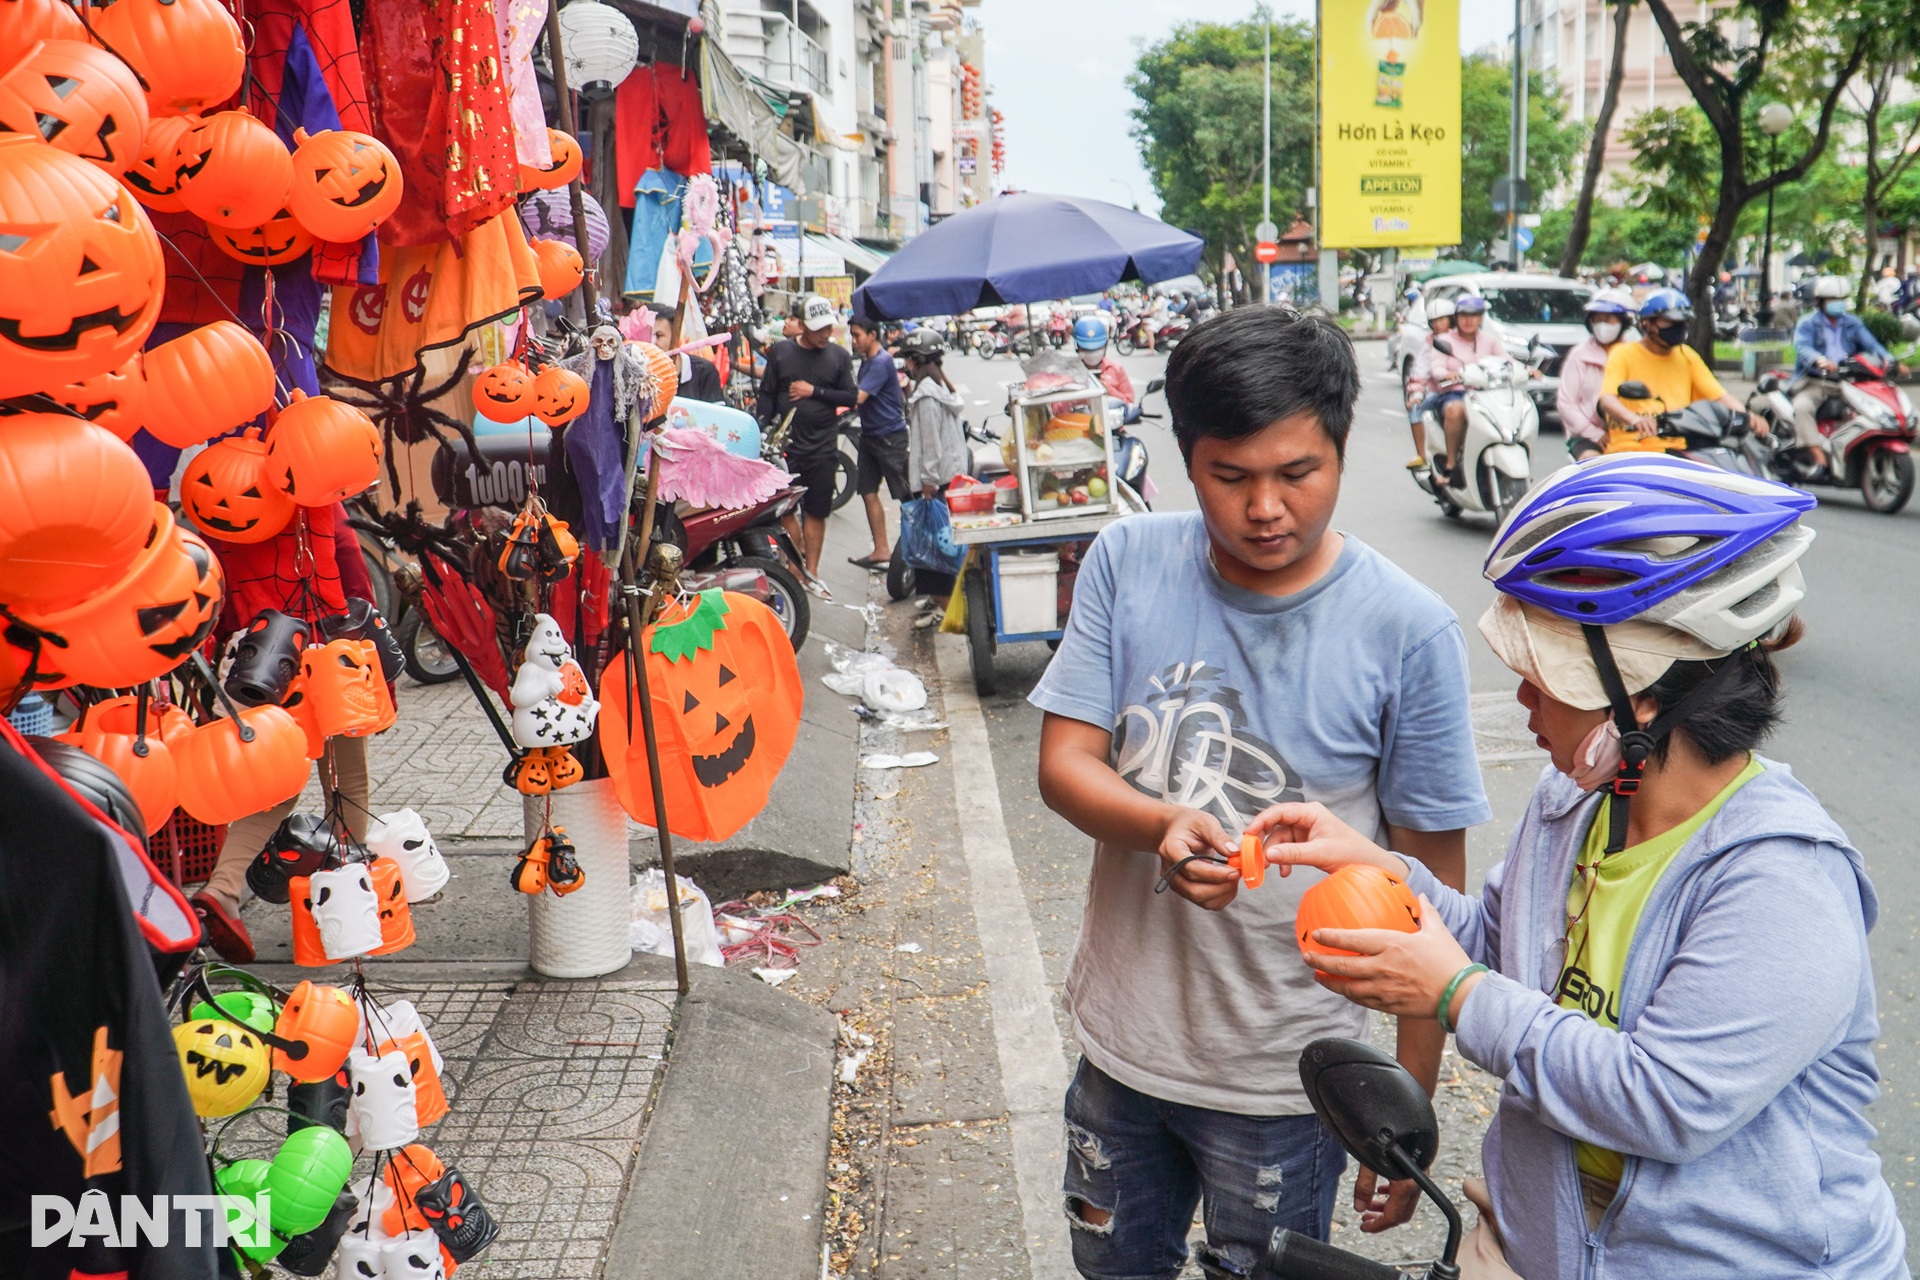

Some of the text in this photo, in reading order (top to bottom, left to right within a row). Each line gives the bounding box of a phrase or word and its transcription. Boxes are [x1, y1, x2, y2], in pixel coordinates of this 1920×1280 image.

[1338, 119, 1445, 146] Hơn Là Kẹo
[1369, 160, 1413, 168] VITAMIN C
[1364, 179, 1420, 192] APPETON
[1369, 205, 1405, 214] VITAMIN
